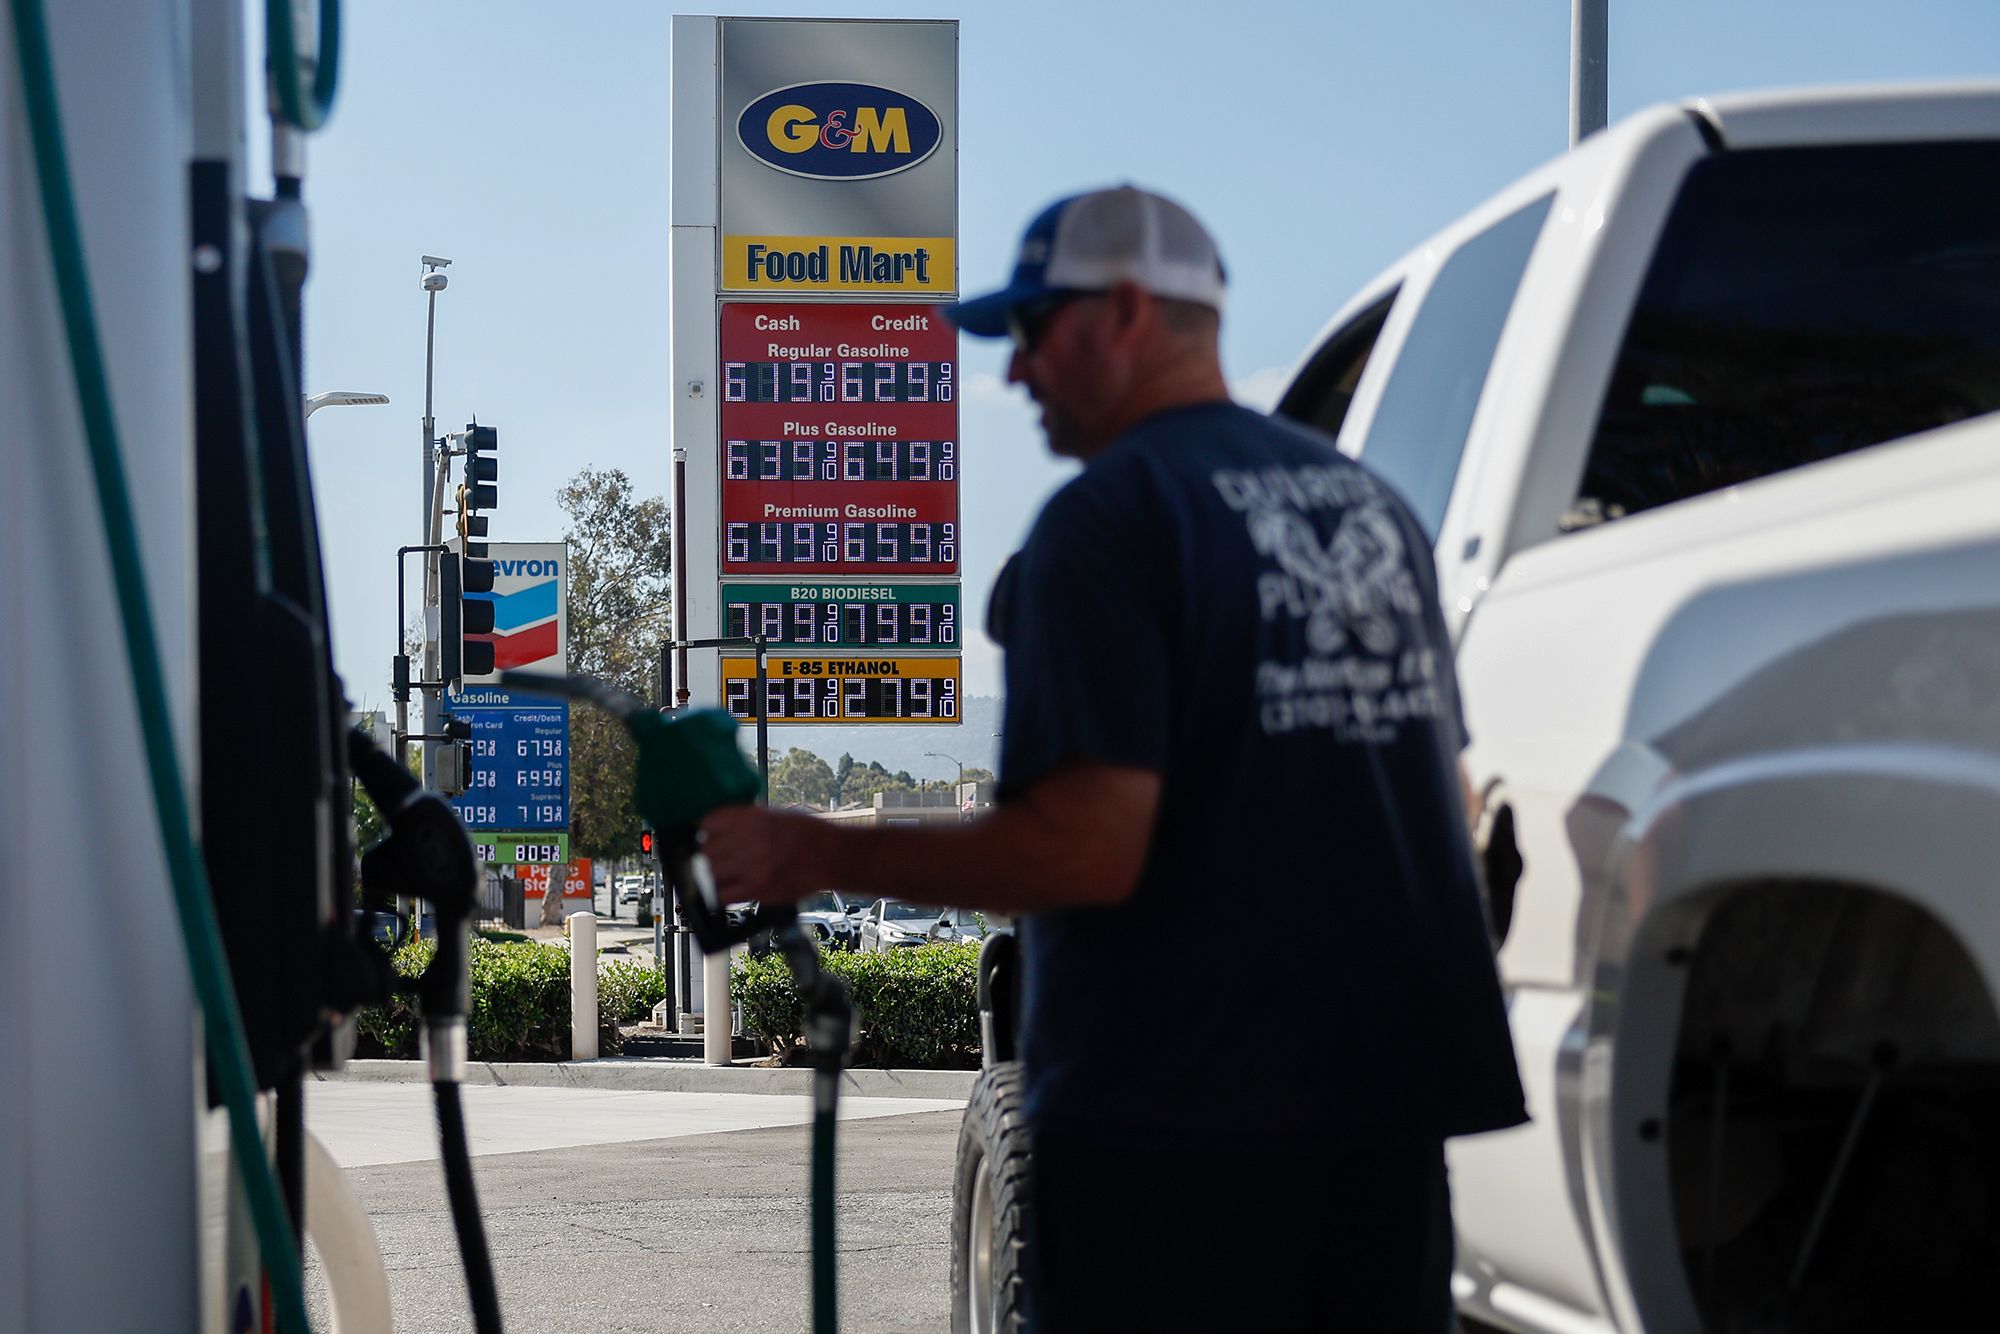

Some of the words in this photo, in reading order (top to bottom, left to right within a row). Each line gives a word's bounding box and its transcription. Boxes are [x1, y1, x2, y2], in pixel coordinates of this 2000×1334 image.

[767, 104, 912, 154] G&M
[747, 244, 829, 282] Food
[839, 245, 930, 284] Mart
[754, 315, 800, 331] Cash
[871, 315, 928, 331] Credit
[768, 344, 832, 360] Regular
[838, 344, 909, 358] Gasoline
[784, 422, 819, 436] Plus
[824, 422, 897, 436] Gasoline
[764, 504, 838, 518] Premium
[844, 504, 917, 518] Gasoline
[494, 560, 558, 577] evron
[790, 588, 818, 600] B20
[822, 588, 896, 600] BIODIESEL
[782, 661, 822, 675] E-85
[828, 661, 900, 675] ETHANOL
[452, 692, 510, 704] Gasoline
[514, 714, 561, 722] Credit/Debit
[530, 865, 578, 878] Puc
[524, 878, 585, 894] Stoge
